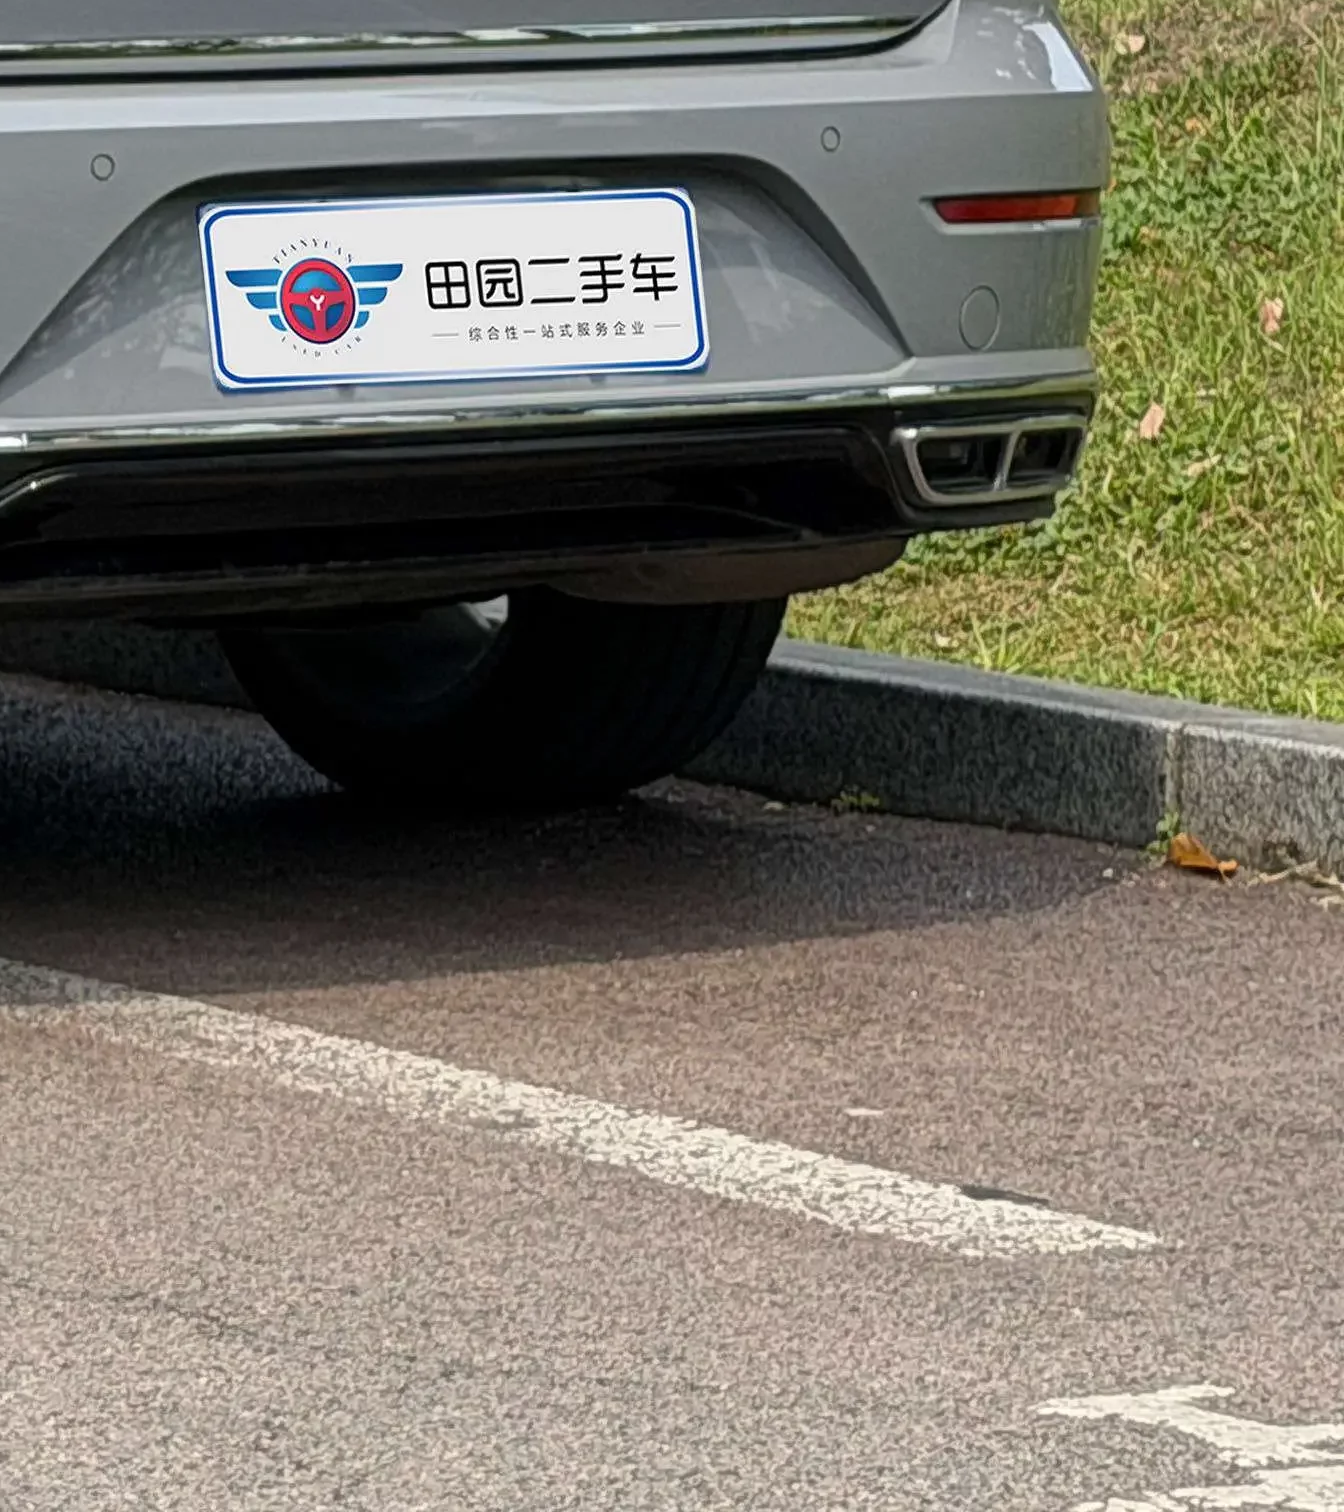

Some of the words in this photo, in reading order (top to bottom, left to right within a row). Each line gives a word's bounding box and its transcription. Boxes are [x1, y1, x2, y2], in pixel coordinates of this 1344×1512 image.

[425, 253, 679, 310] 田园二手车
[468, 320, 645, 342] 综合性一站式服务企业
